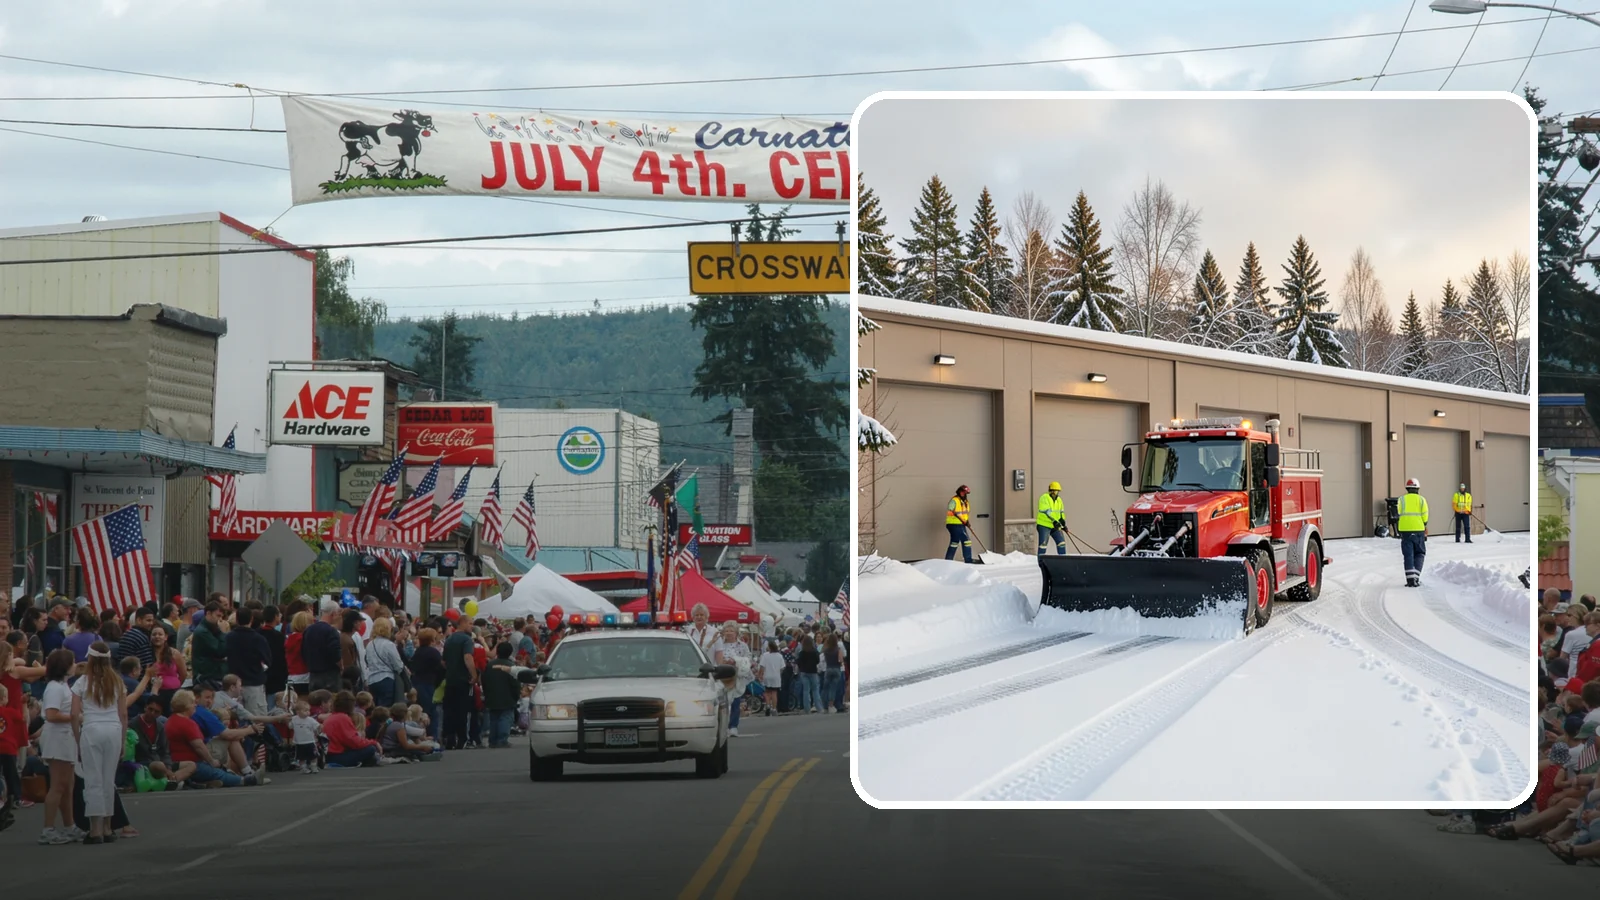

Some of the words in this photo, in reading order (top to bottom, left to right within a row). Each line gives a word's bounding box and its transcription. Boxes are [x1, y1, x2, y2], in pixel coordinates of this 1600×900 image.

[481, 141, 605, 192] JULY
[632, 150, 746, 197] 4th.
[697, 254, 850, 280] CROSSWA
[283, 380, 373, 419] ACE
[405, 409, 452, 422] CEDAR
[461, 409, 485, 422] LOG
[283, 421, 370, 436] Hardware
[353, 467, 386, 480] Simpl
[96, 485, 124, 494] Vincent
[126, 485, 136, 494] de
[138, 486, 155, 495] Paul
[212, 515, 331, 536] HARDARE
[688, 527, 742, 535] CRNATION
[699, 535, 730, 543] GLASS
